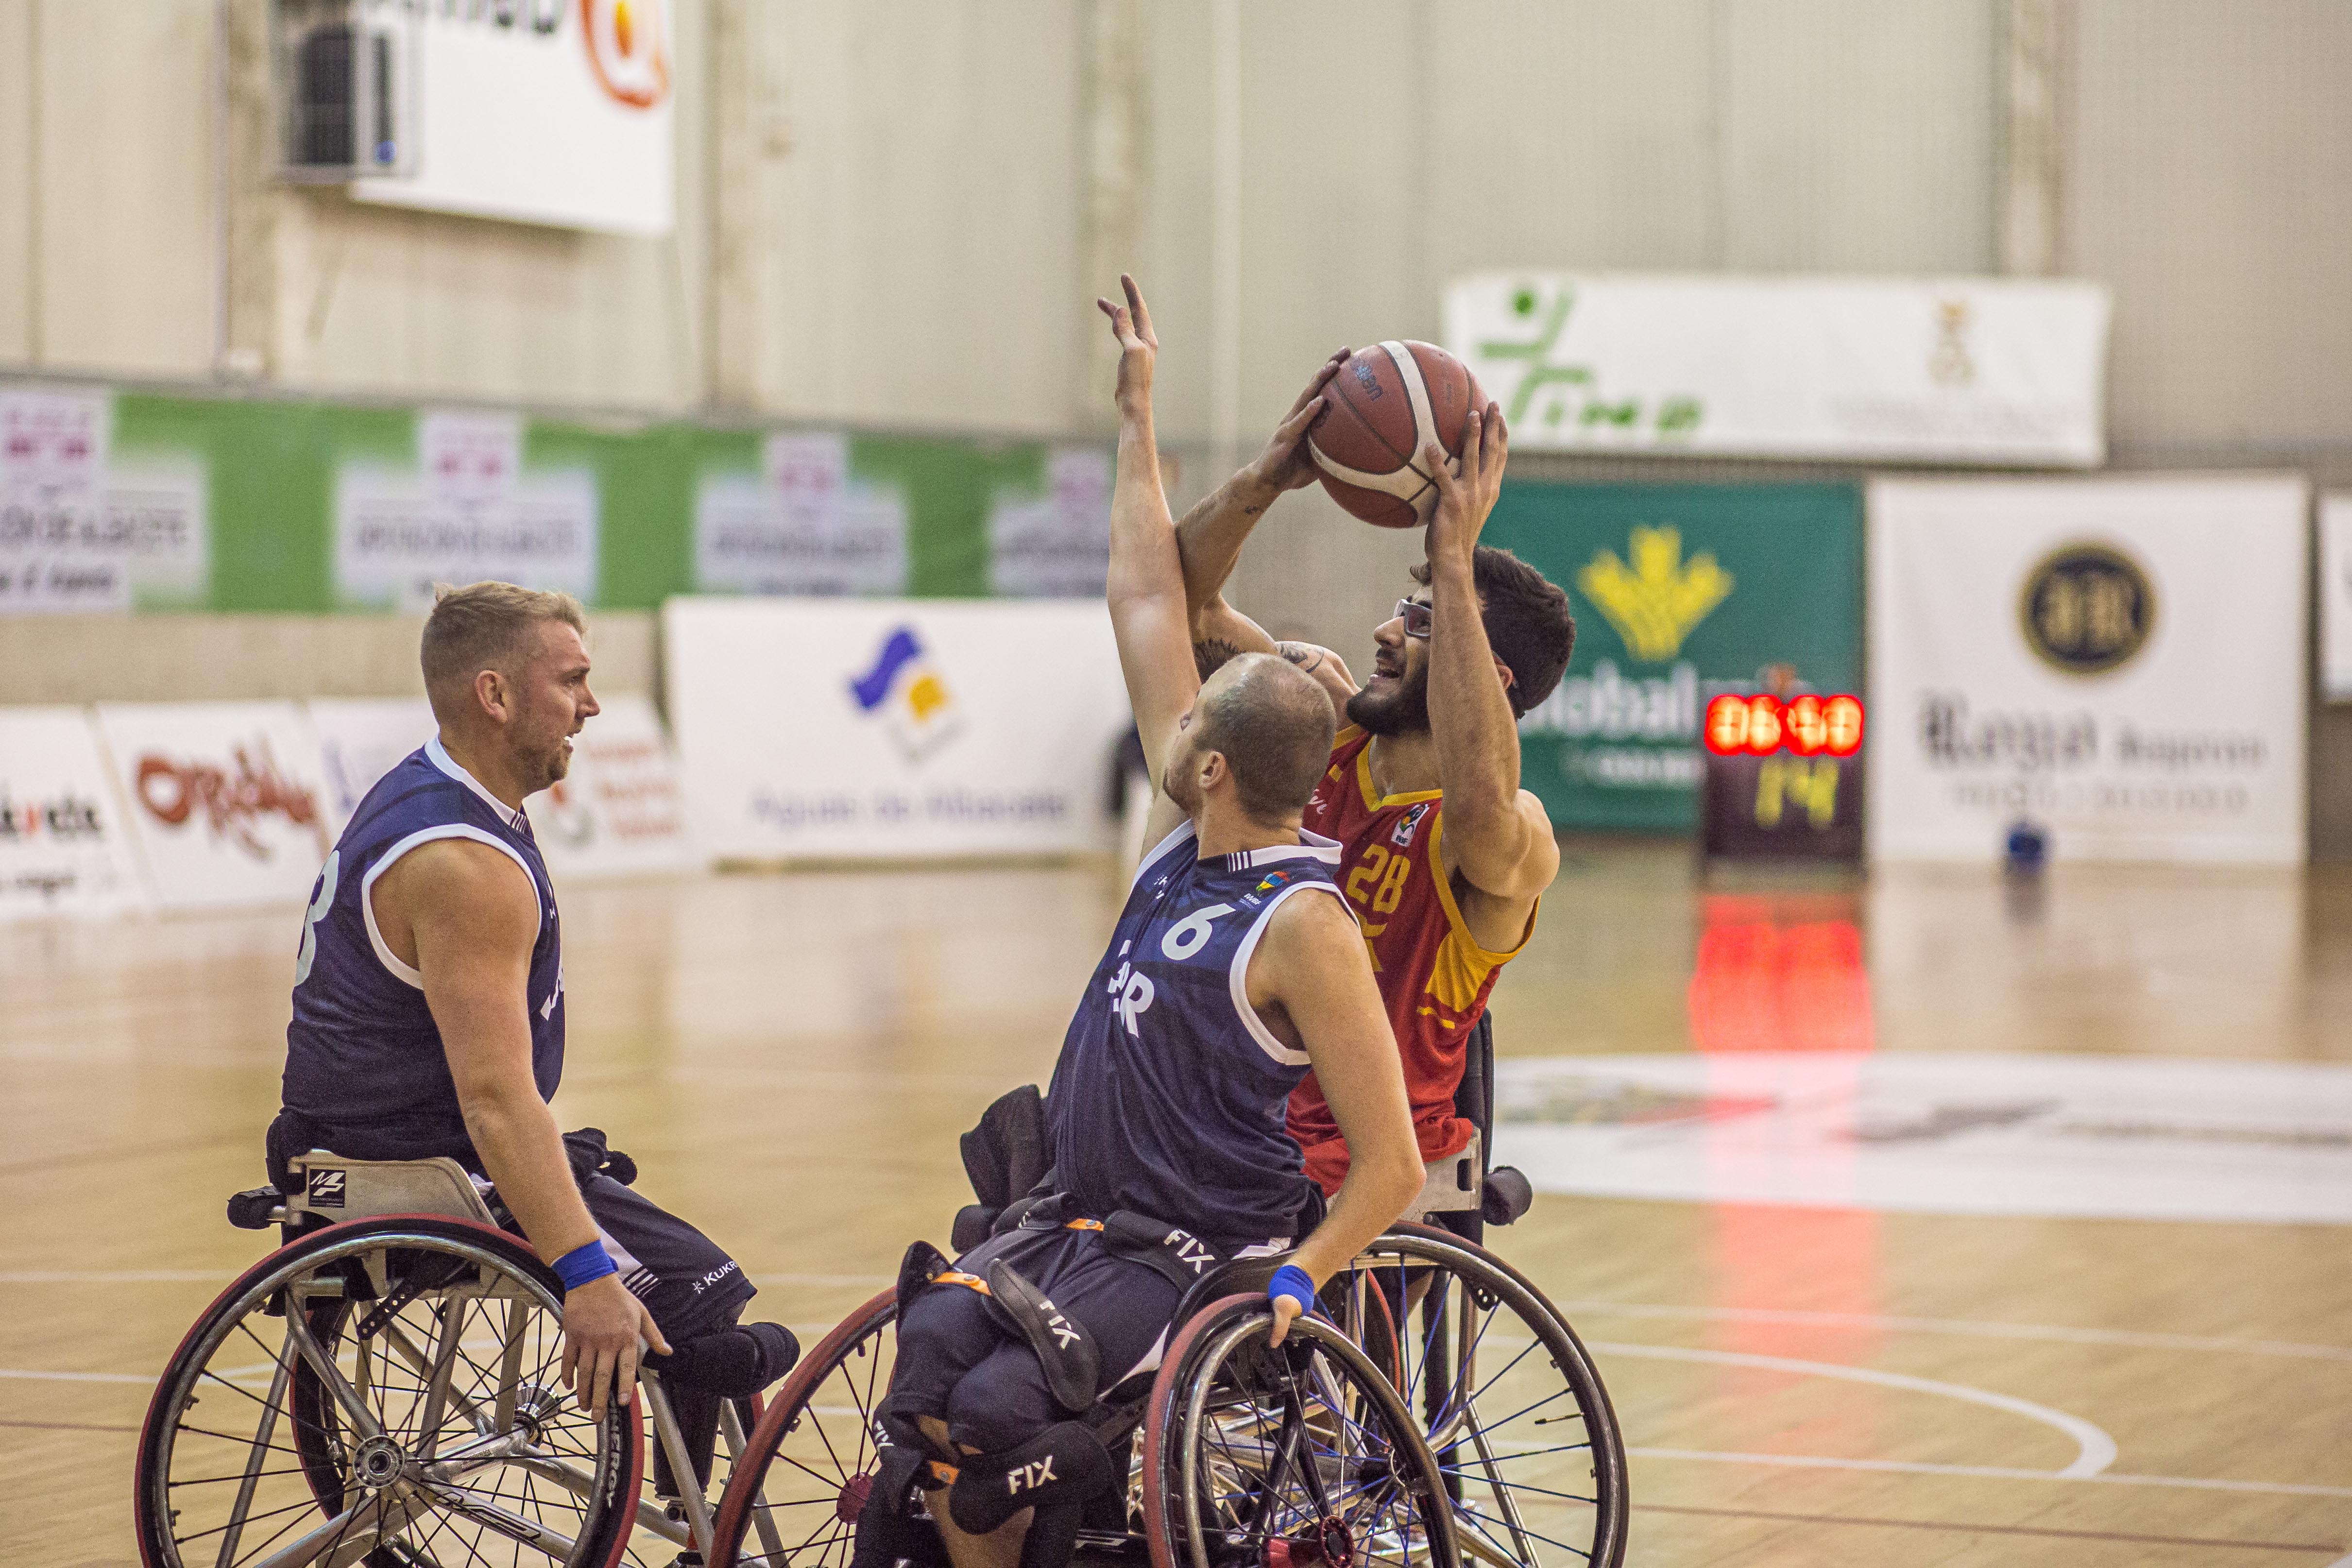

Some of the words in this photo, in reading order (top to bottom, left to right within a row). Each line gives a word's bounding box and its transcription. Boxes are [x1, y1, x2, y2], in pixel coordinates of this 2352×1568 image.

[1520, 659, 1696, 738] lobal
[1346, 844, 1411, 914] 28
[1161, 903, 1235, 960] 6
[1163, 1228, 1215, 1274] FIX
[1008, 1455, 1058, 1495] FIX
